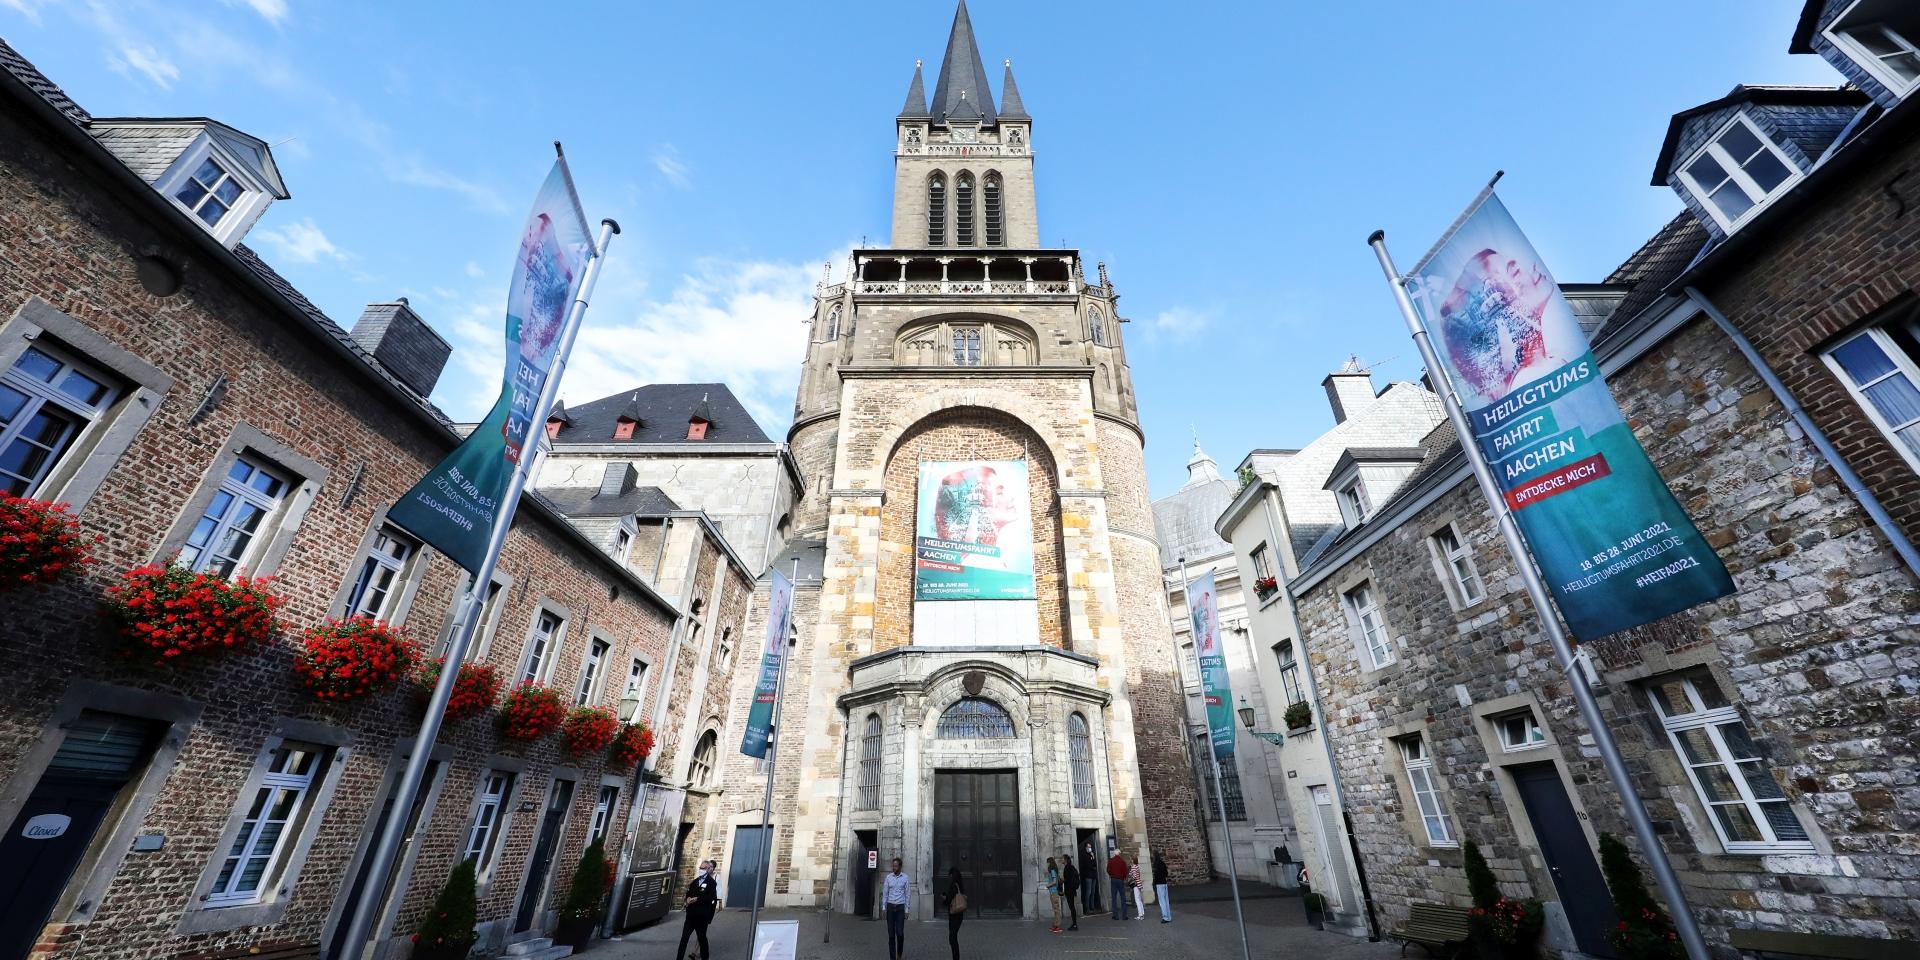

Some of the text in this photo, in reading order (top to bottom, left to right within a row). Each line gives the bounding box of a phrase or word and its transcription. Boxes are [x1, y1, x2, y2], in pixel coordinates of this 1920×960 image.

[1483, 362, 1589, 426] HEILIGTUMS
[1494, 416, 1544, 452] FAHRT
[1506, 437, 1575, 480] AACHEN
[1515, 463, 1596, 502] ENTDECKE MICH
[923, 551, 957, 560] AACHEN
[924, 538, 995, 556] HEILIGTUMSFAHRT
[1580, 521, 1671, 571] 18. BIS 28. JUNI 2021
[1636, 556, 1700, 588] #HEIFA2021
[28, 825, 60, 836] Closed
